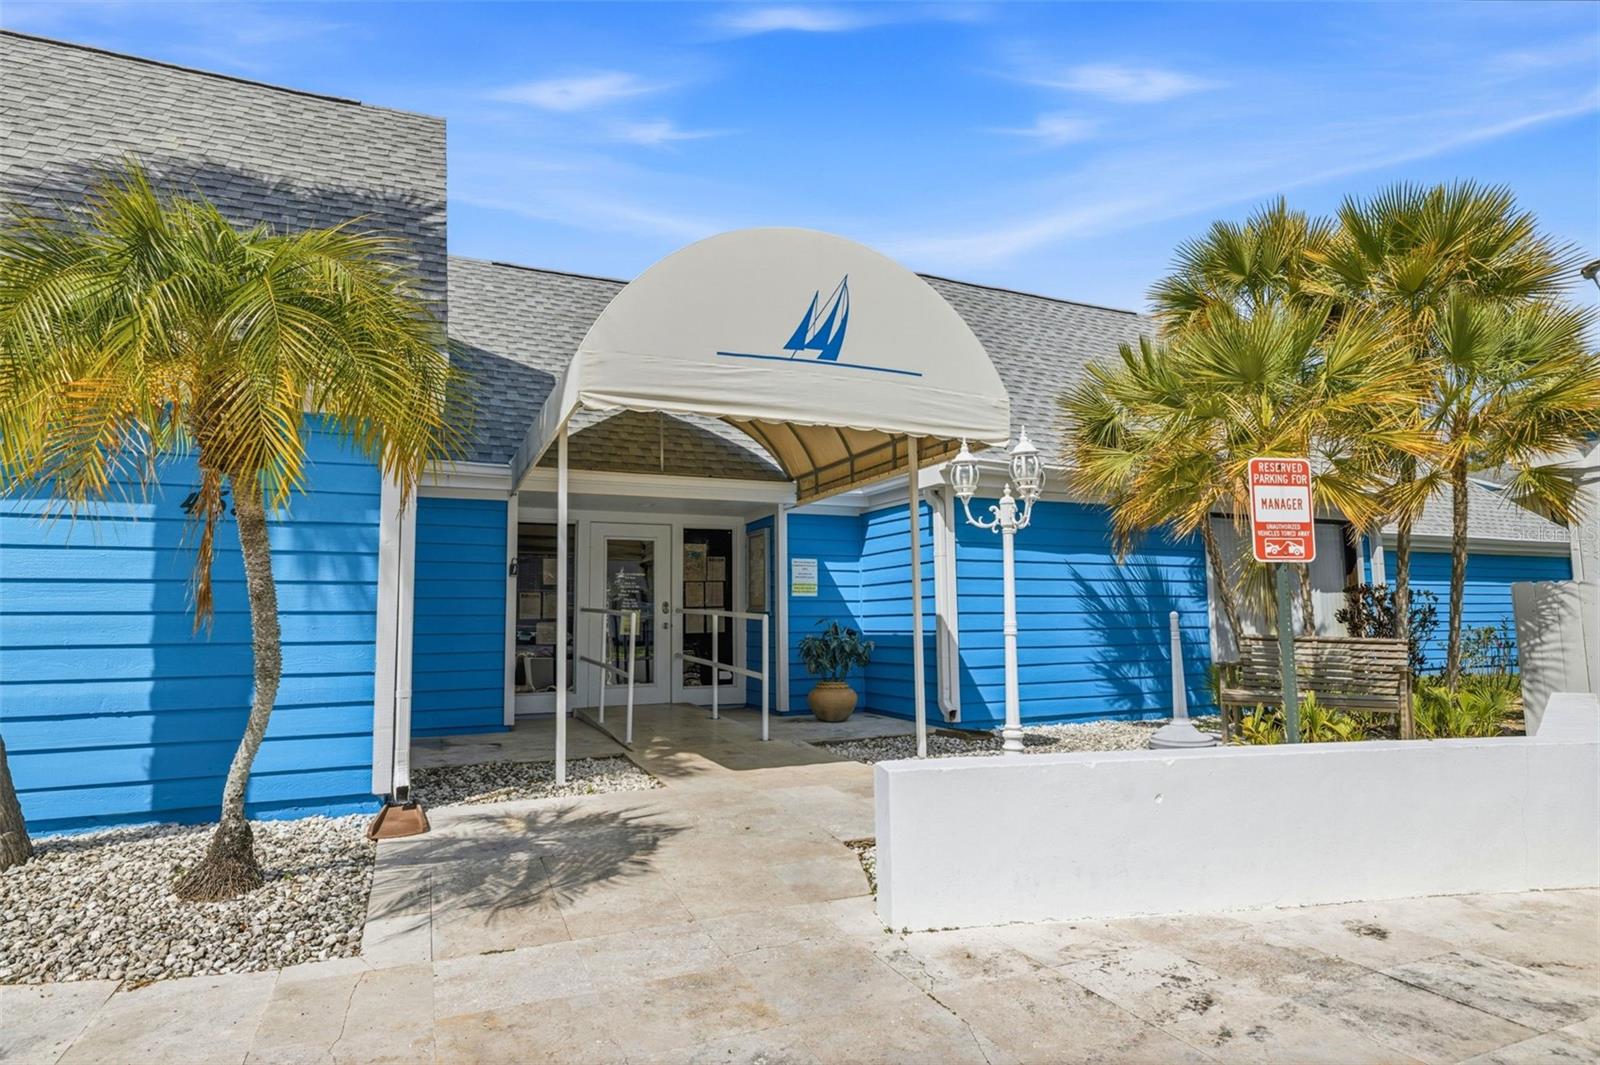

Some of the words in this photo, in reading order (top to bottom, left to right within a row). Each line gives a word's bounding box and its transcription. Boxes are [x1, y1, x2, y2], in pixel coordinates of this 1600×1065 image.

[1258, 462, 1303, 473] RESERVED
[1253, 473, 1289, 484] PARKING
[1291, 474, 1307, 484] FOR
[1261, 498, 1303, 510] MANAGER
